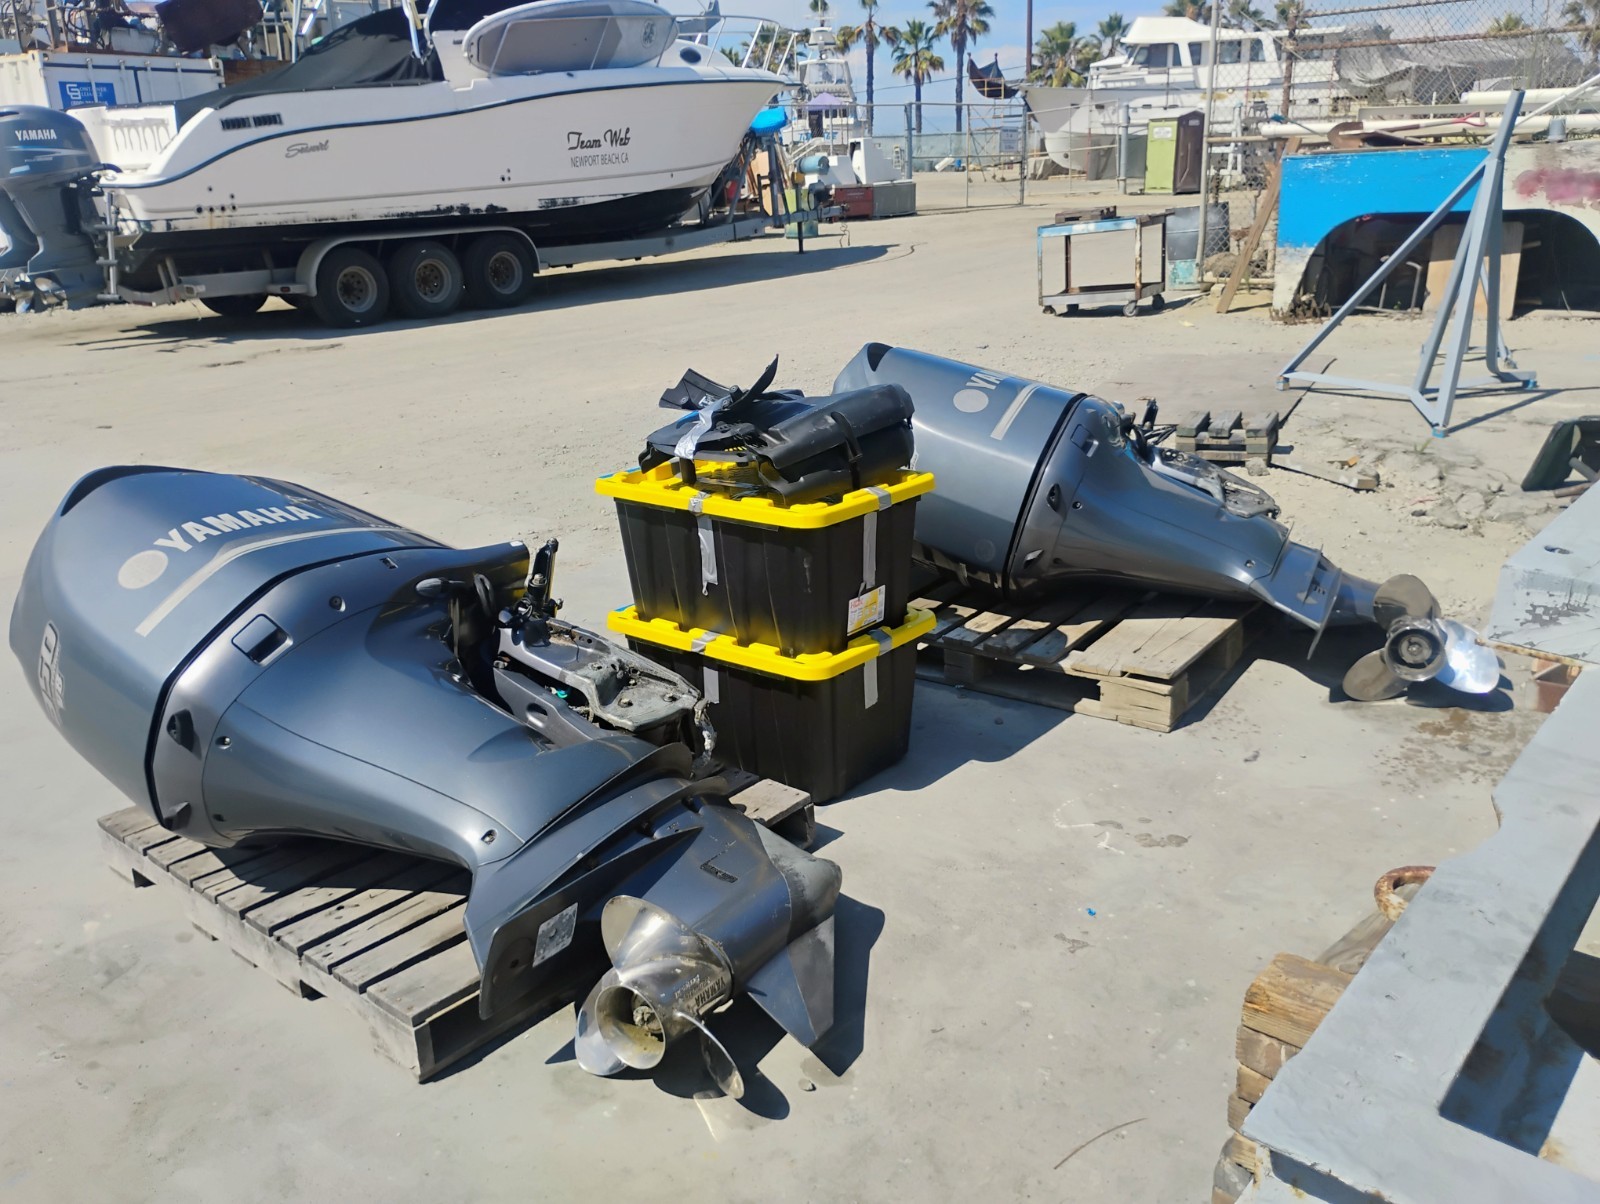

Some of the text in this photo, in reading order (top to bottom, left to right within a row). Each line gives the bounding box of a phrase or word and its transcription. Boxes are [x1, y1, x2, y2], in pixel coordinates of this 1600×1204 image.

[15, 129, 57, 141] YAMAHA
[567, 131, 602, 150] Team
[571, 154, 600, 168] NEWPORT
[153, 505, 323, 552] YAMAHA
[694, 976, 726, 1008] YAMAHA
